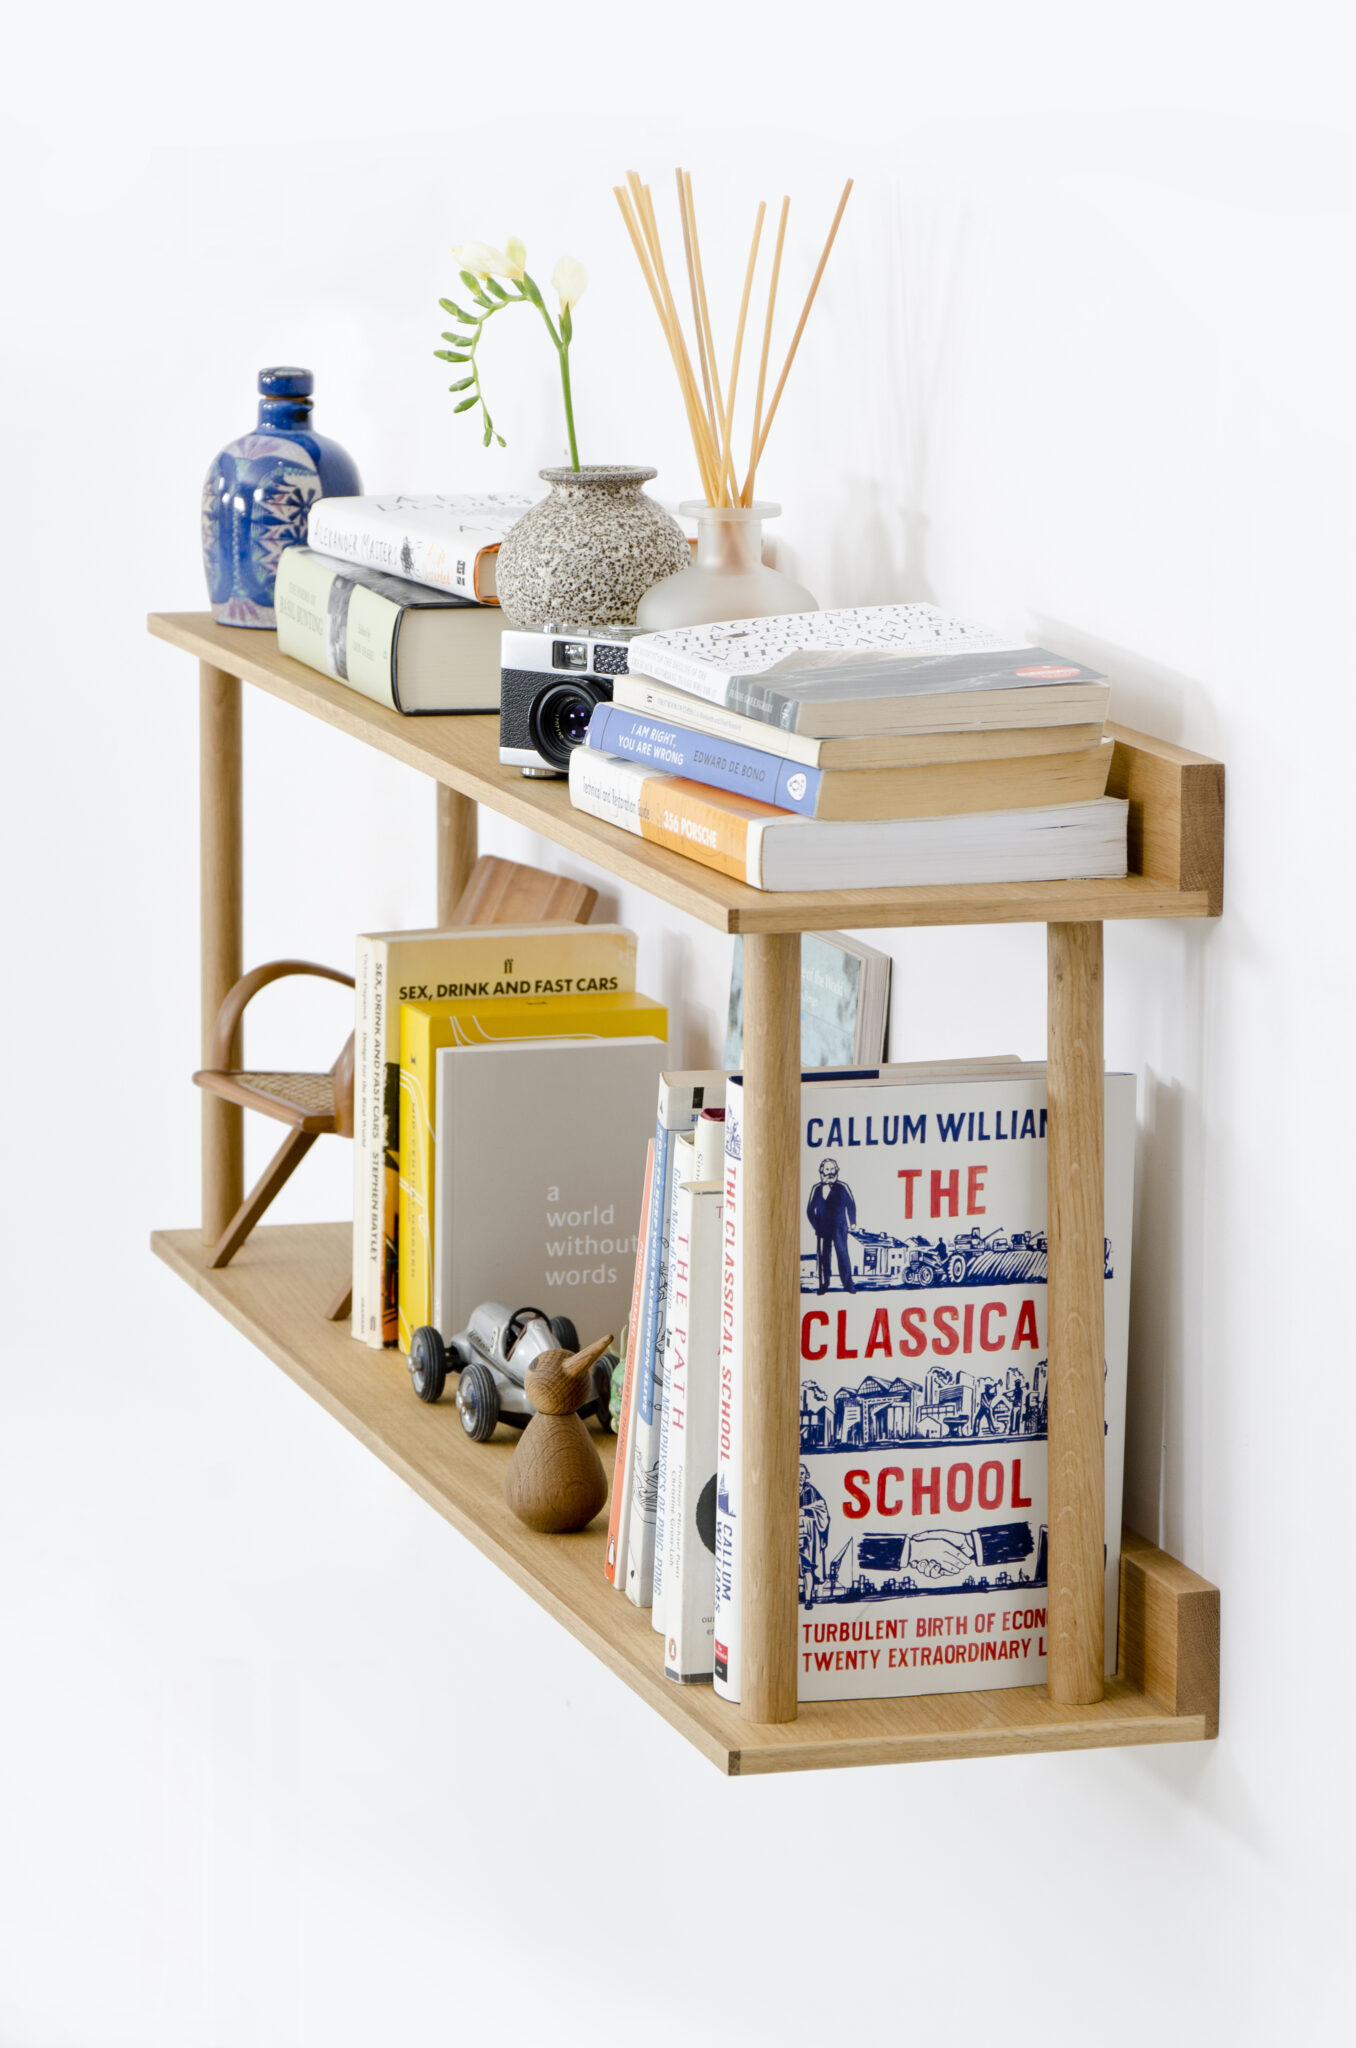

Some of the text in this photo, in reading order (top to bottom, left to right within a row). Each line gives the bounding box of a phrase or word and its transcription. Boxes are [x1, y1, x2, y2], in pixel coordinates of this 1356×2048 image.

[313, 519, 398, 566] ALEXANDER MASTERS
[651, 628, 692, 641] AN
[710, 607, 865, 632] ACCOUNT
[698, 644, 804, 662] WHO
[618, 735, 685, 766] YOU ARE WRONG
[631, 723, 677, 749] I AM RIGHT,
[693, 750, 766, 782] EDWARD DE BONO
[663, 810, 718, 849] 356 PORSCHE
[399, 976, 618, 1001] SEX, DRINK AND FAST CARS
[370, 962, 383, 1263] SEX, DRINK AND FAST CARS STEPHEN BAYLEY
[806, 1108, 1048, 1148] CALLUM WILLIA
[546, 1185, 560, 1202] a
[898, 1165, 988, 1220] THE
[546, 1204, 615, 1228] world
[545, 1235, 640, 1257] without
[544, 1263, 618, 1287] words
[672, 1233, 690, 1430] THE PATH
[720, 1166, 738, 1462] THE CLASSICAL SCHOOL
[801, 1299, 1041, 1361] CLASSICA
[653, 1367, 672, 1597] THE METAPHYSICS OF PING-PONG
[842, 1458, 1033, 1520] SCHOOL
[721, 1522, 733, 1602] CALLUM
[802, 1608, 1048, 1644] TURBULENT BIRTH OF ECON
[802, 1648, 882, 1673] TWENTY
[888, 1638, 1032, 1669] EXTRAORDINARY
